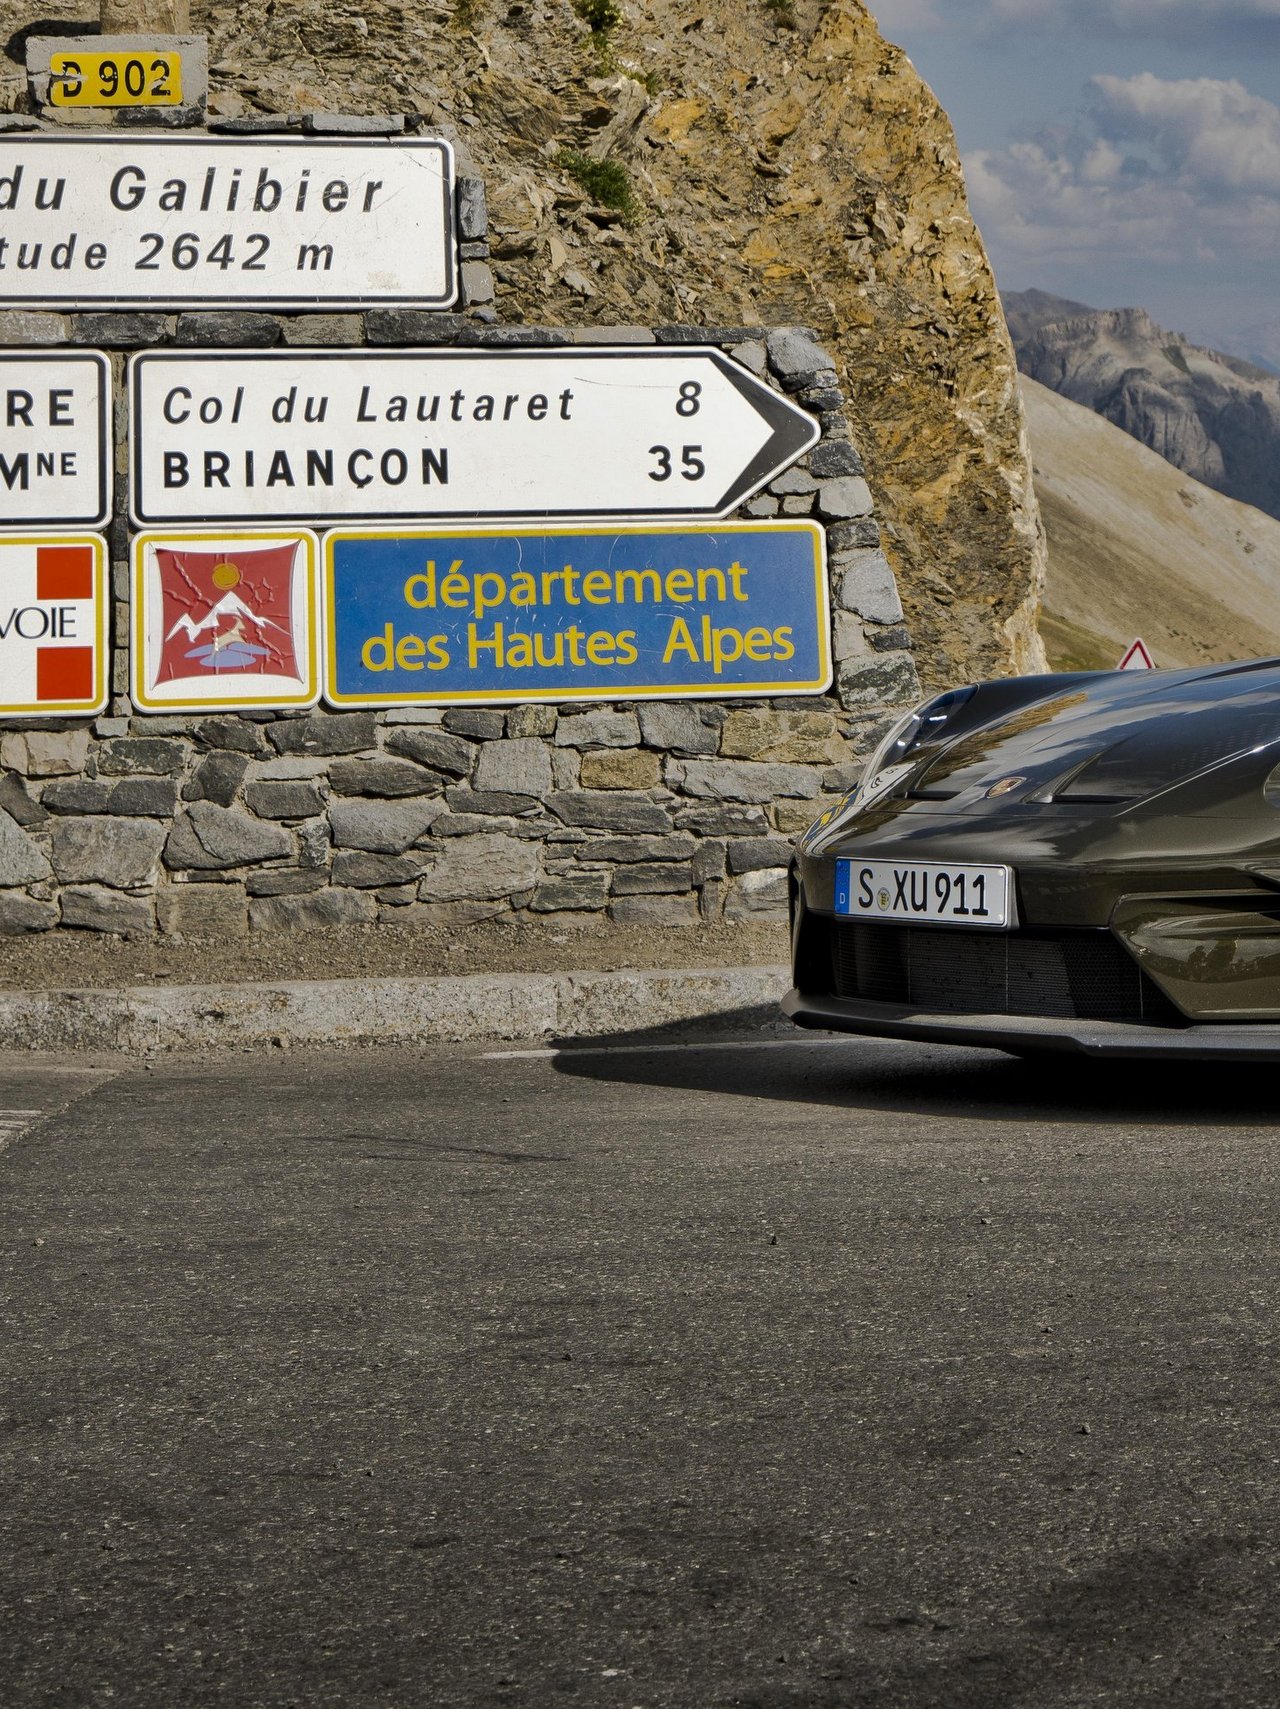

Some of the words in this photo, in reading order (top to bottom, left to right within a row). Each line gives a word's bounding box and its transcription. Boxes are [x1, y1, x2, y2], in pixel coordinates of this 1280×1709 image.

[61, 61, 83, 98] D
[99, 60, 172, 98] 902
[0, 165, 66, 211] du
[110, 164, 384, 213] Galibier
[135, 233, 270, 271] 2642
[297, 242, 334, 271] m
[6, 388, 75, 427] RE
[163, 386, 244, 425] Col
[272, 386, 328, 424] du
[356, 386, 575, 422] Lautaret
[675, 381, 701, 417] 8
[163, 448, 449, 490] BRIANÇON
[648, 445, 706, 482] 35
[404, 558, 748, 613] département
[362, 623, 450, 672] des
[468, 622, 637, 669] Hautes
[663, 614, 795, 674] Alpes
[858, 867, 874, 909] S
